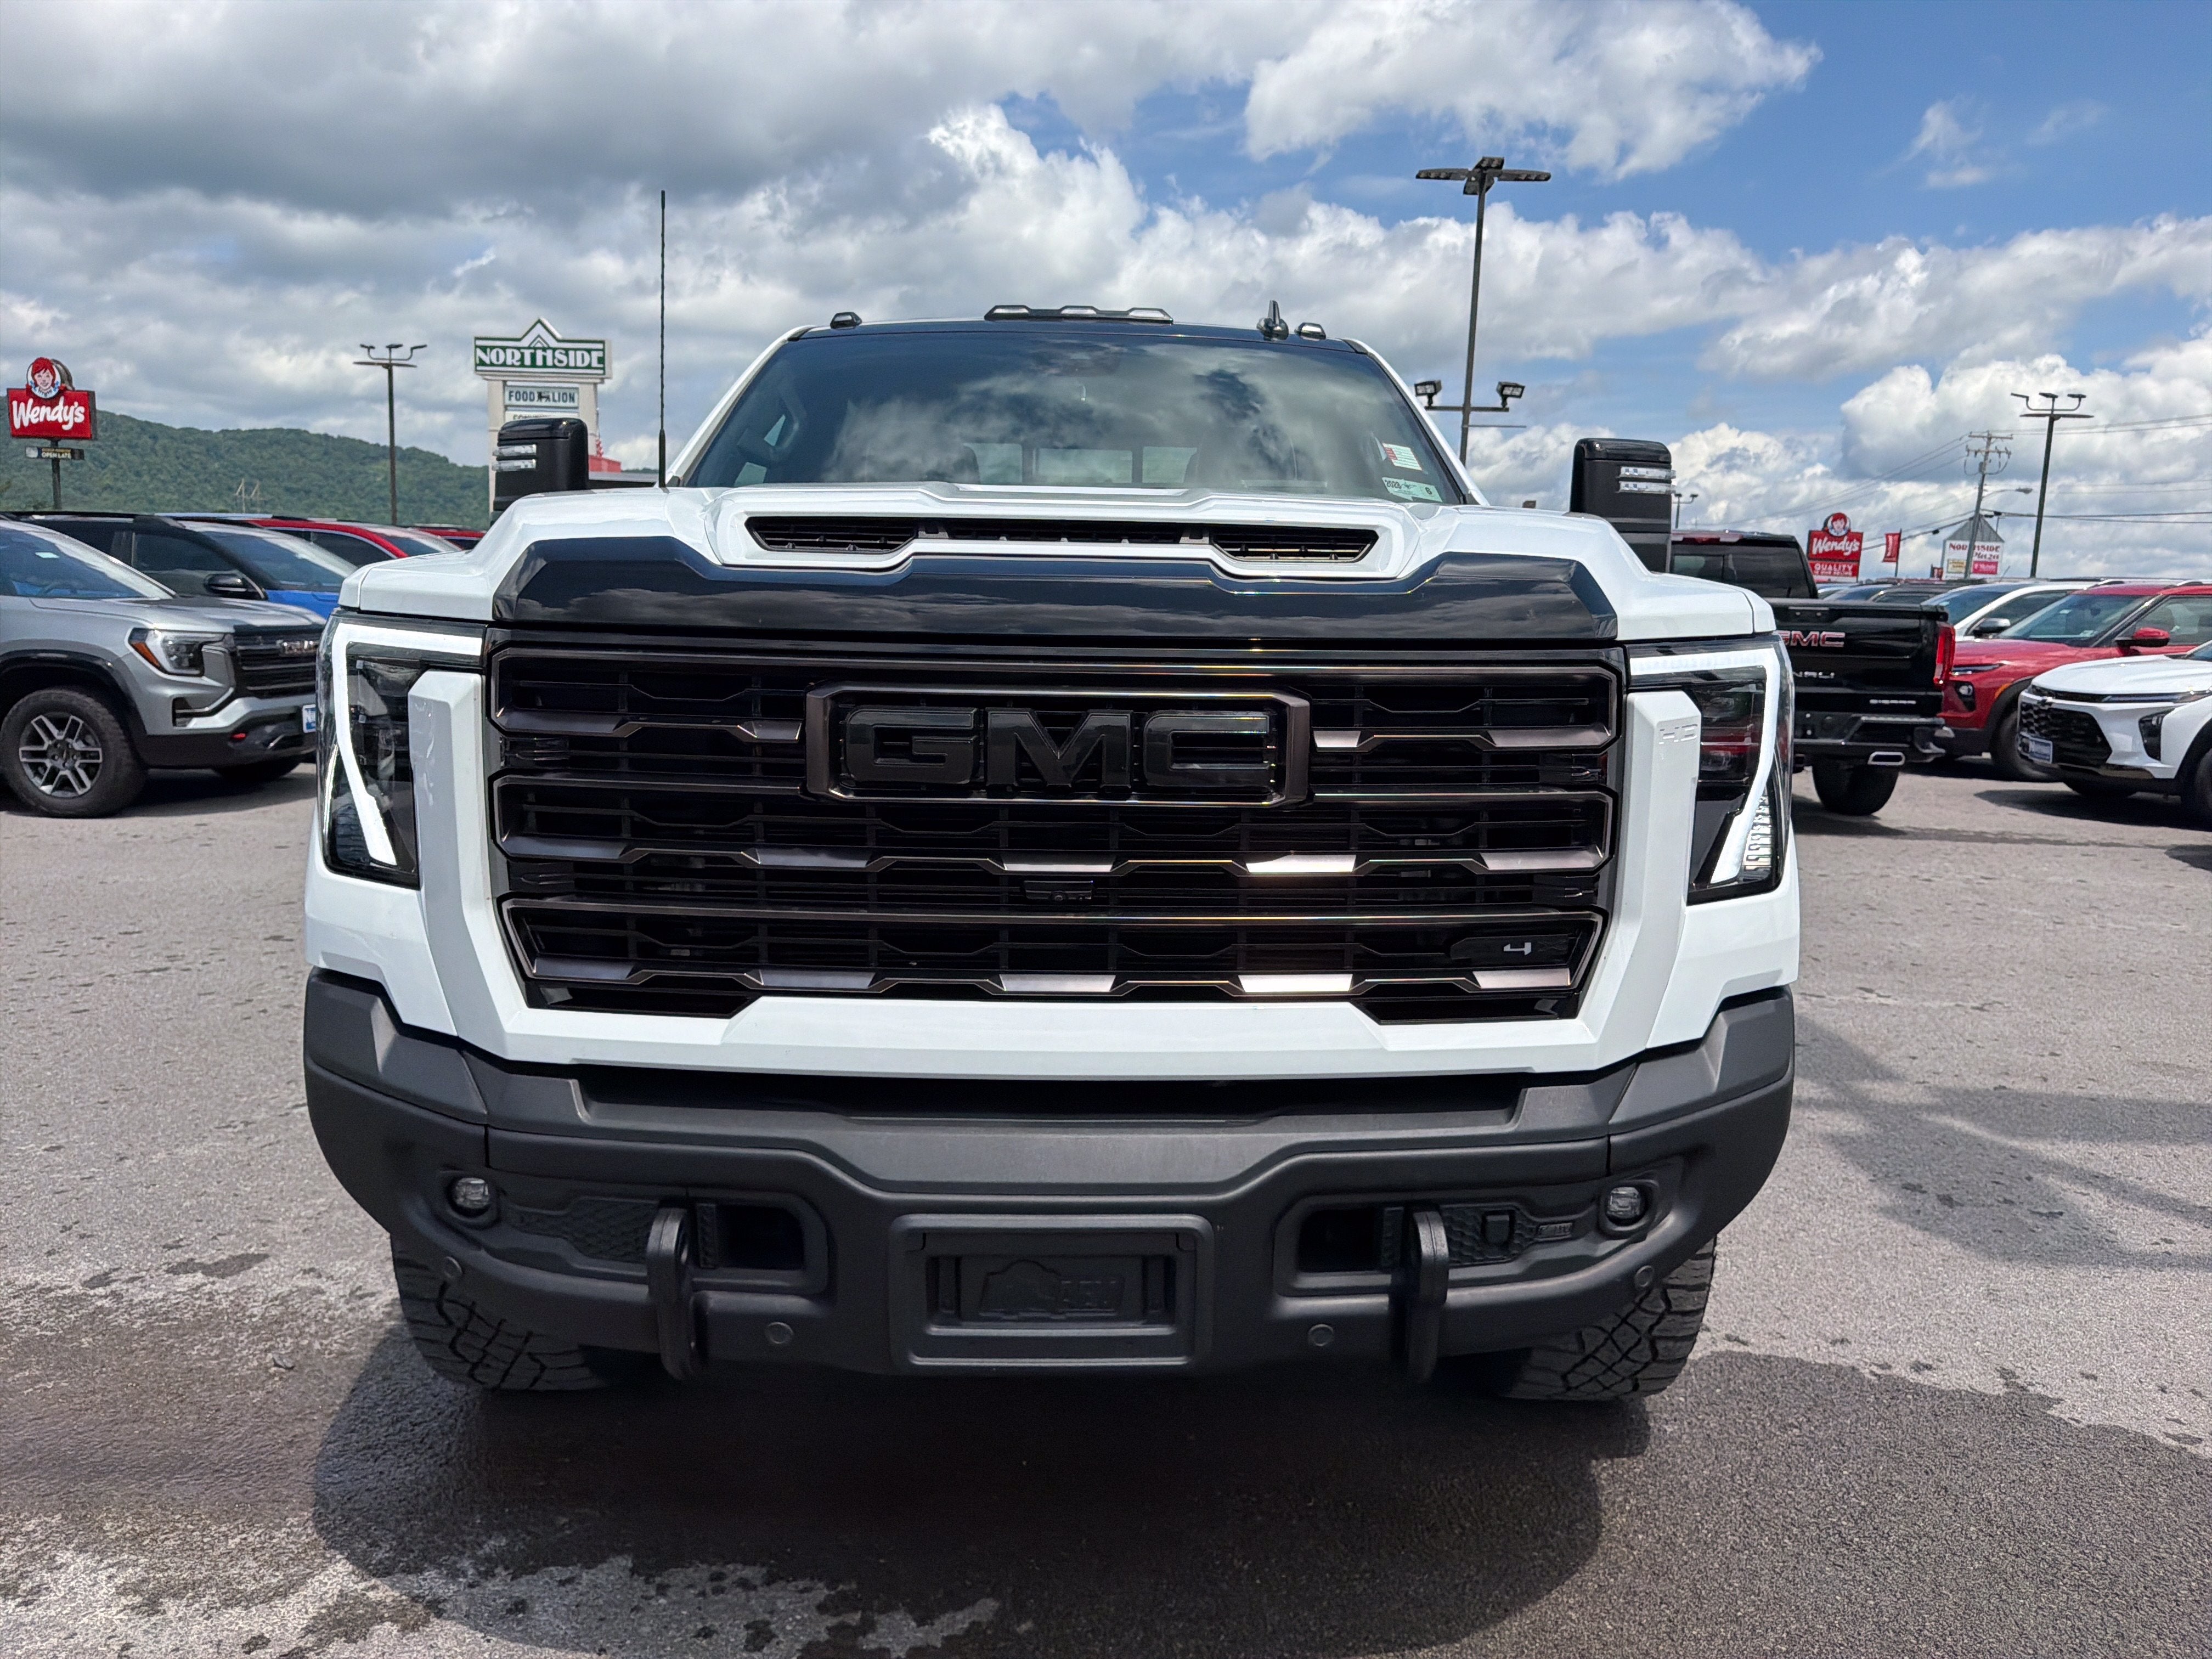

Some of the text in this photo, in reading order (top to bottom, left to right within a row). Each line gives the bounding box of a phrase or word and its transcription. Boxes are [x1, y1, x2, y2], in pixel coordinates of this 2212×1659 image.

[476, 347, 603, 368] NORTHSIDE
[509, 390, 575, 403] FOOD LION
[12, 396, 84, 430] Wendy's
[1812, 536, 1860, 556] Wendy's
[1814, 562, 1853, 571] QUALITY
[845, 706, 1271, 789] GMC
